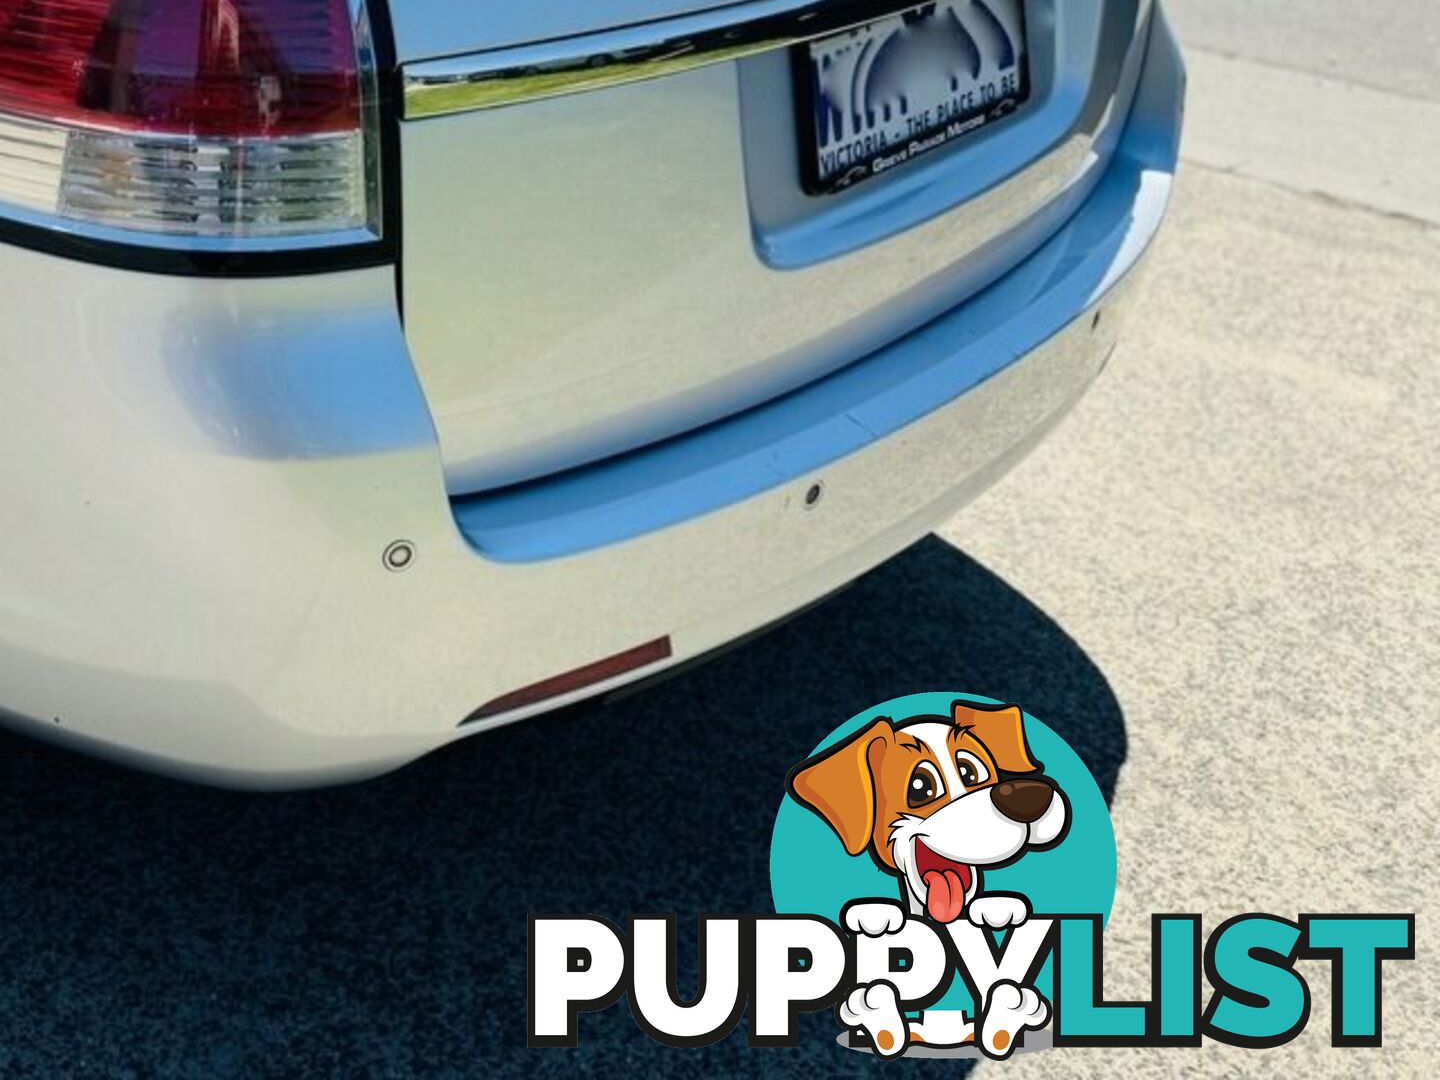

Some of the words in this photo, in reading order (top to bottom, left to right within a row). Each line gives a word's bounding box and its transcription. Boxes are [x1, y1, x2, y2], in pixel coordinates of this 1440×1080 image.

[820, 129, 887, 173] VICTORIA
[906, 109, 930, 139] THE
[937, 91, 973, 124] PLACE
[979, 81, 997, 104] TO
[1001, 72, 1016, 98] BE
